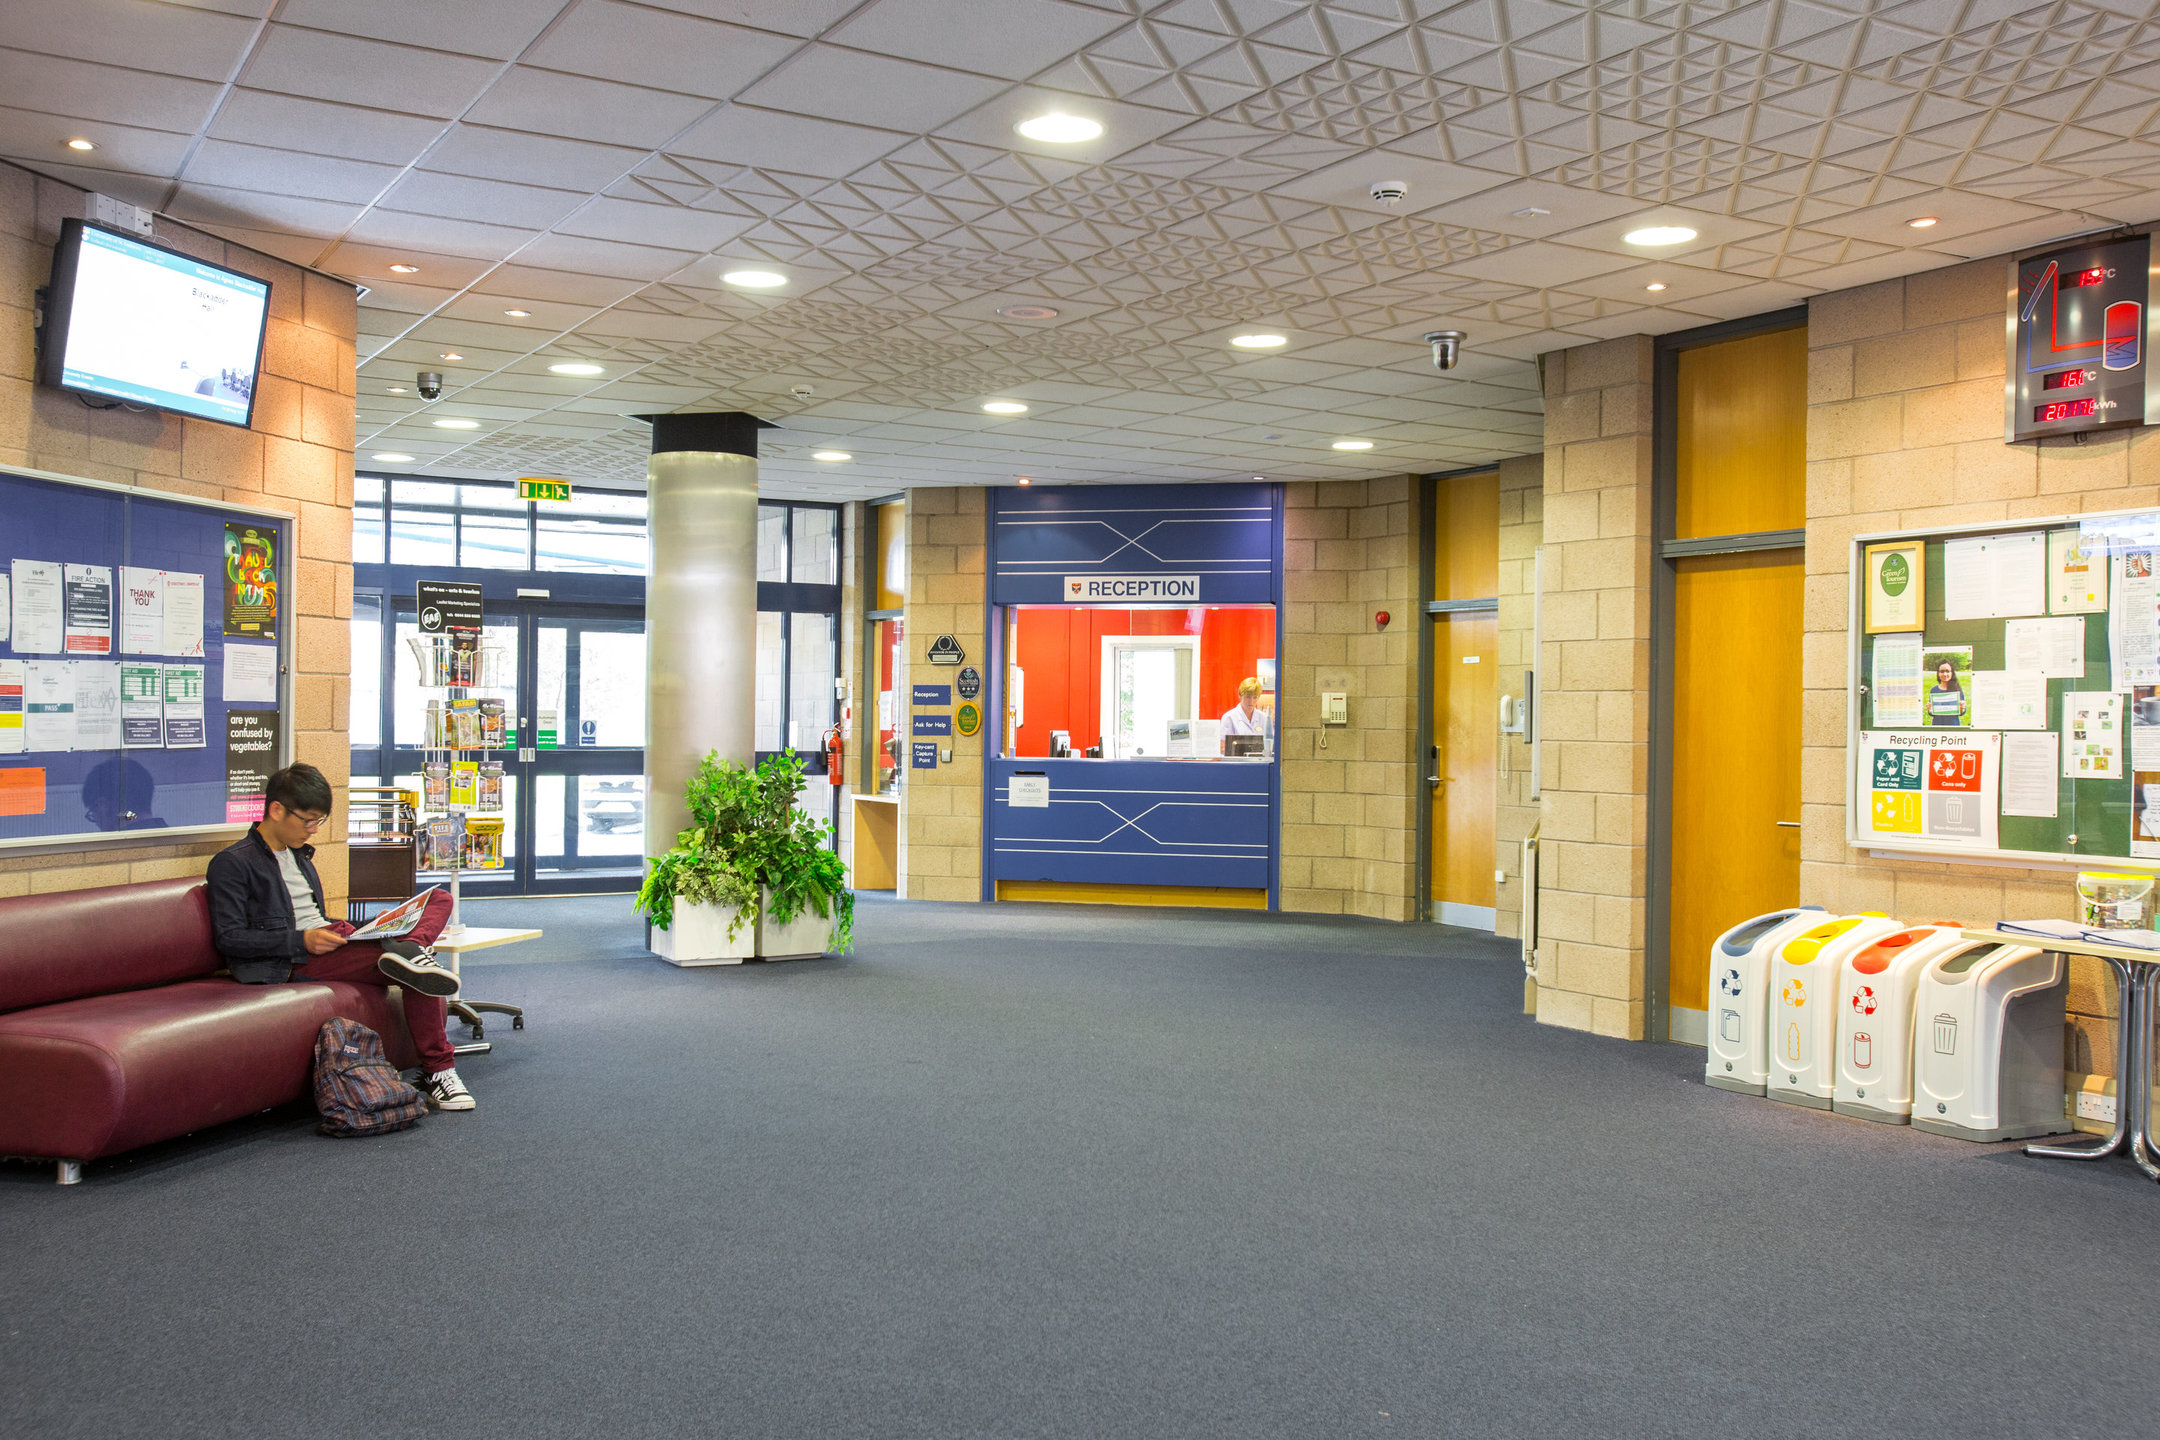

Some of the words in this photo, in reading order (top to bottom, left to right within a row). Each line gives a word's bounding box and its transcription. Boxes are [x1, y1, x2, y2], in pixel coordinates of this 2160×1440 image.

[129, 588, 156, 599] THANK
[1088, 580, 1195, 597] RECEPTION
[134, 597, 150, 606] YOU
[230, 716, 243, 725] are
[244, 716, 258, 727] you
[230, 727, 263, 738] confused
[263, 727, 273, 740] by
[230, 740, 272, 754] vegetables?
[1889, 735, 1938, 748] Recycling
[1940, 735, 1967, 746] Point
